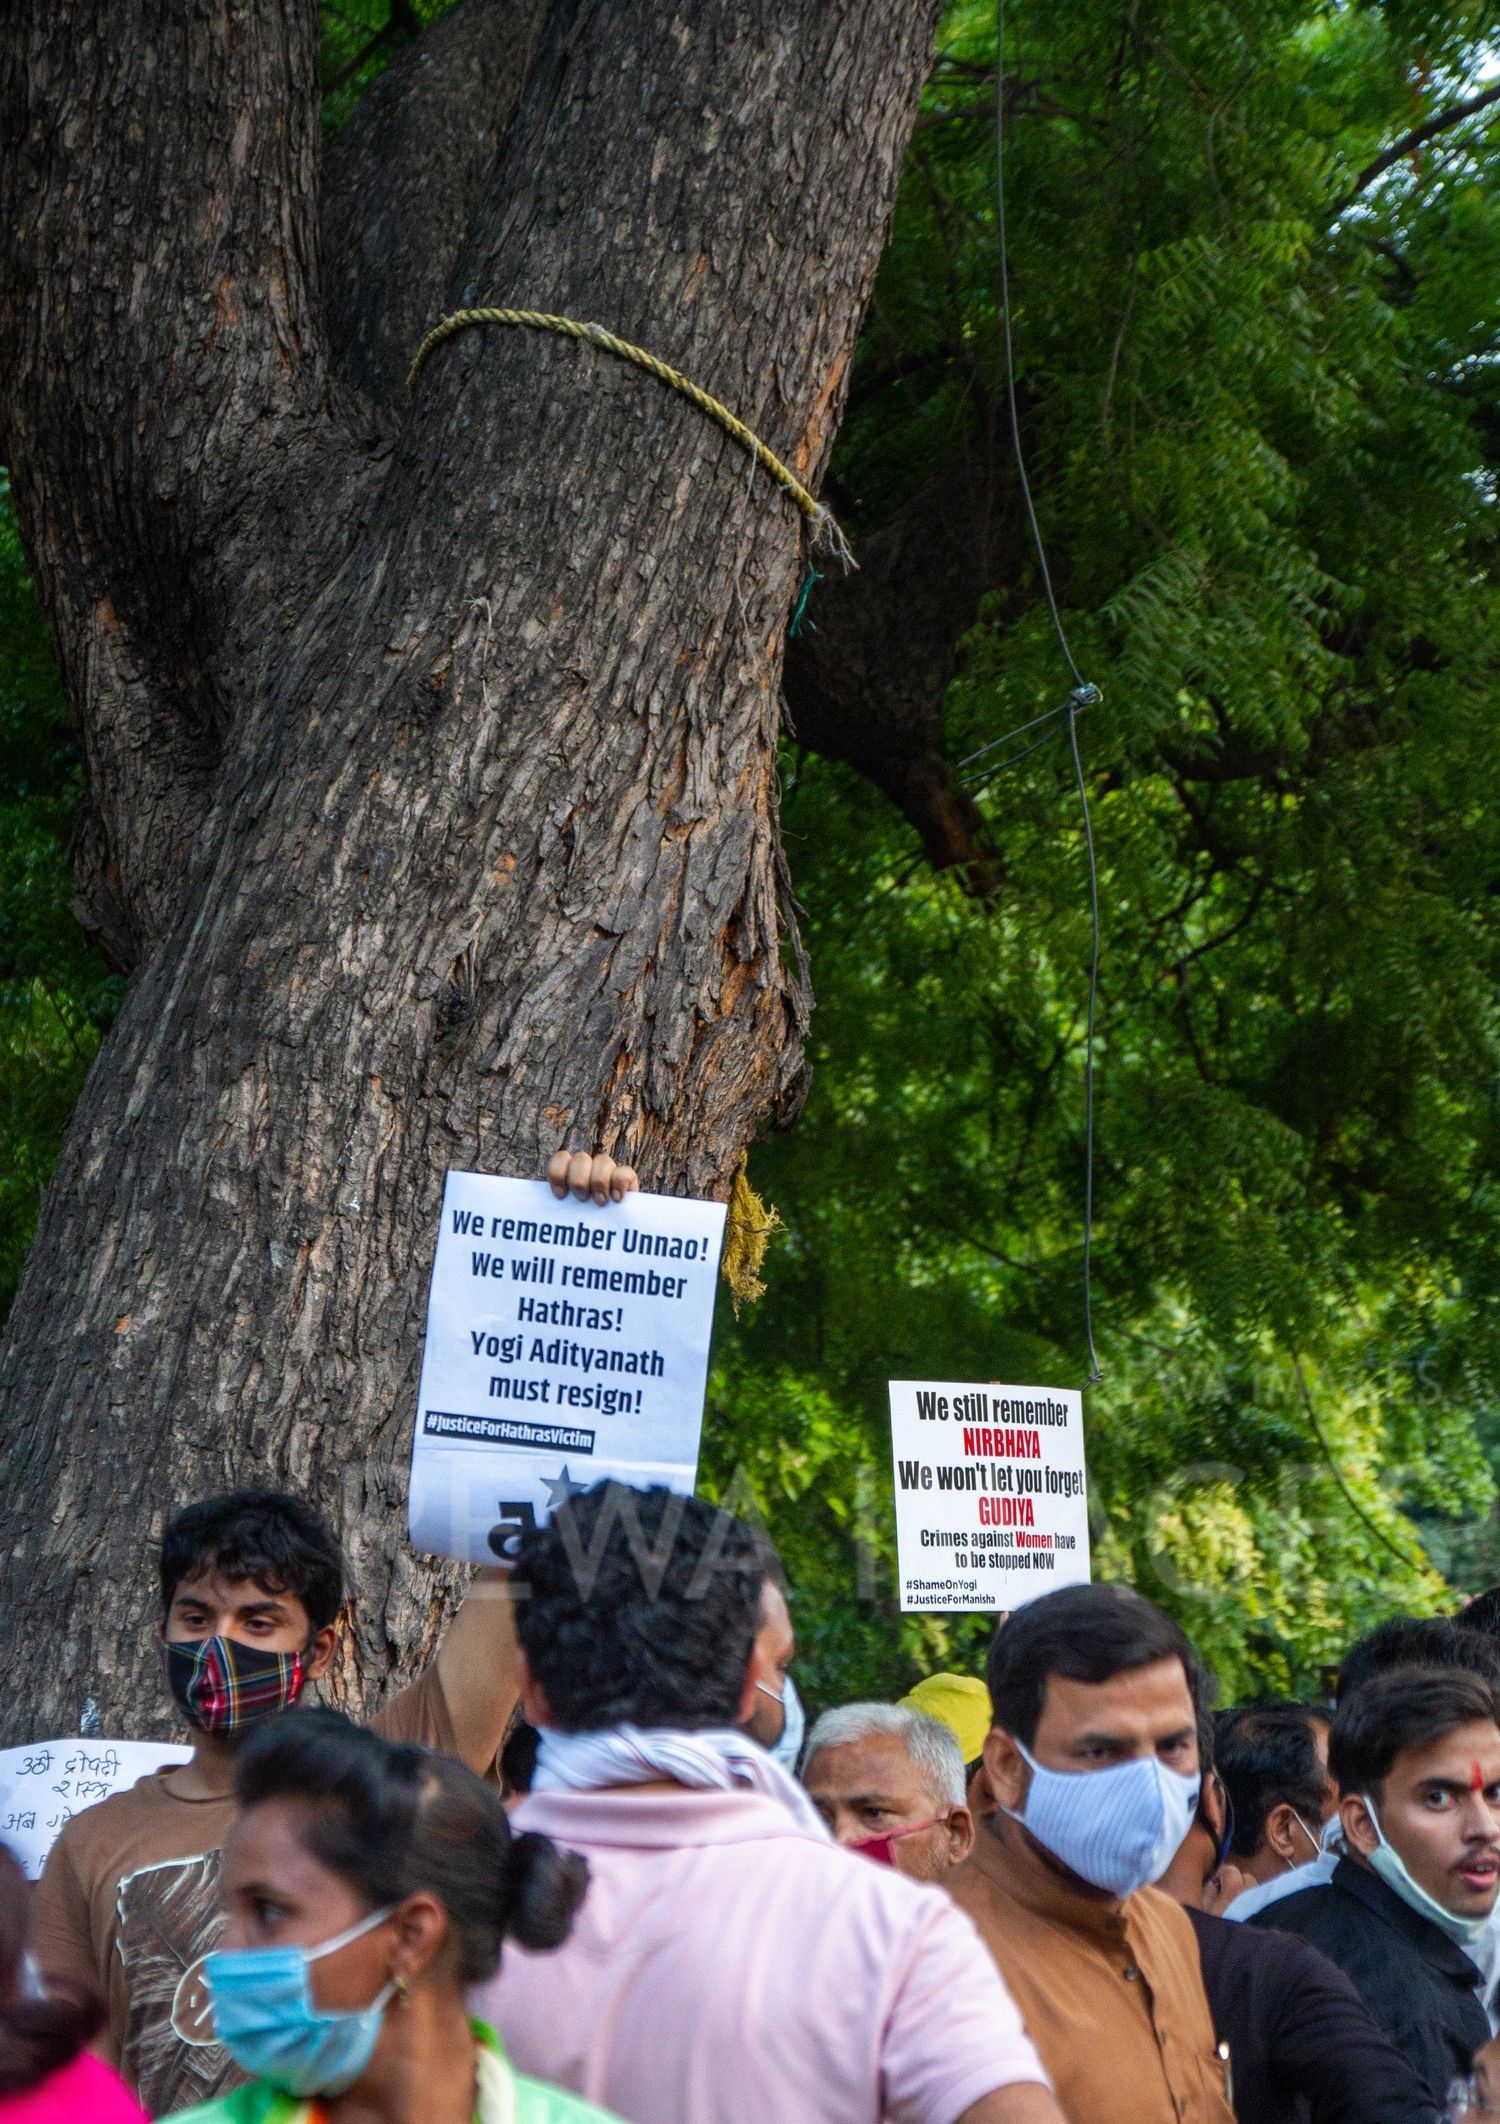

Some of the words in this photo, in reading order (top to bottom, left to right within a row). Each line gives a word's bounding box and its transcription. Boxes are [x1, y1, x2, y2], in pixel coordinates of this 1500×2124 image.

[452, 1210, 484, 1237] We
[491, 1215, 616, 1251] remember
[622, 1228, 709, 1261] Unnao!
[471, 1252, 504, 1278] We
[511, 1257, 554, 1285] will
[562, 1263, 687, 1298] remember
[517, 1297, 623, 1332] Hathras!
[471, 1331, 523, 1363] Yogi
[529, 1338, 665, 1377] Adityanath
[489, 1375, 550, 1403] must
[557, 1382, 642, 1415] resign!
[916, 1391, 949, 1421] We
[954, 1393, 988, 1422] still
[993, 1397, 1068, 1427] remember
[426, 1414, 593, 1448] #JusticeForHathrasVictim
[963, 1427, 1041, 1459] NIRBHAYA
[898, 1461, 932, 1490] We
[937, 1462, 988, 1491] won't
[991, 1463, 1013, 1492] let
[1016, 1469, 1042, 1495] you
[1045, 1466, 1083, 1498] forget
[978, 1497, 1034, 1527] GUDIYA
[920, 1529, 968, 1547] Crimes
[971, 1532, 1013, 1549] against
[1016, 1531, 1052, 1549] Women
[1055, 1532, 1075, 1550] have
[955, 1552, 967, 1568] to
[971, 1552, 986, 1568] be
[988, 1552, 1031, 1571] stopped
[1033, 1553, 1055, 1569] NOW
[906, 1579, 977, 1592] #ShameOnYogi
[907, 1594, 995, 1605] #JusticeForManisha
